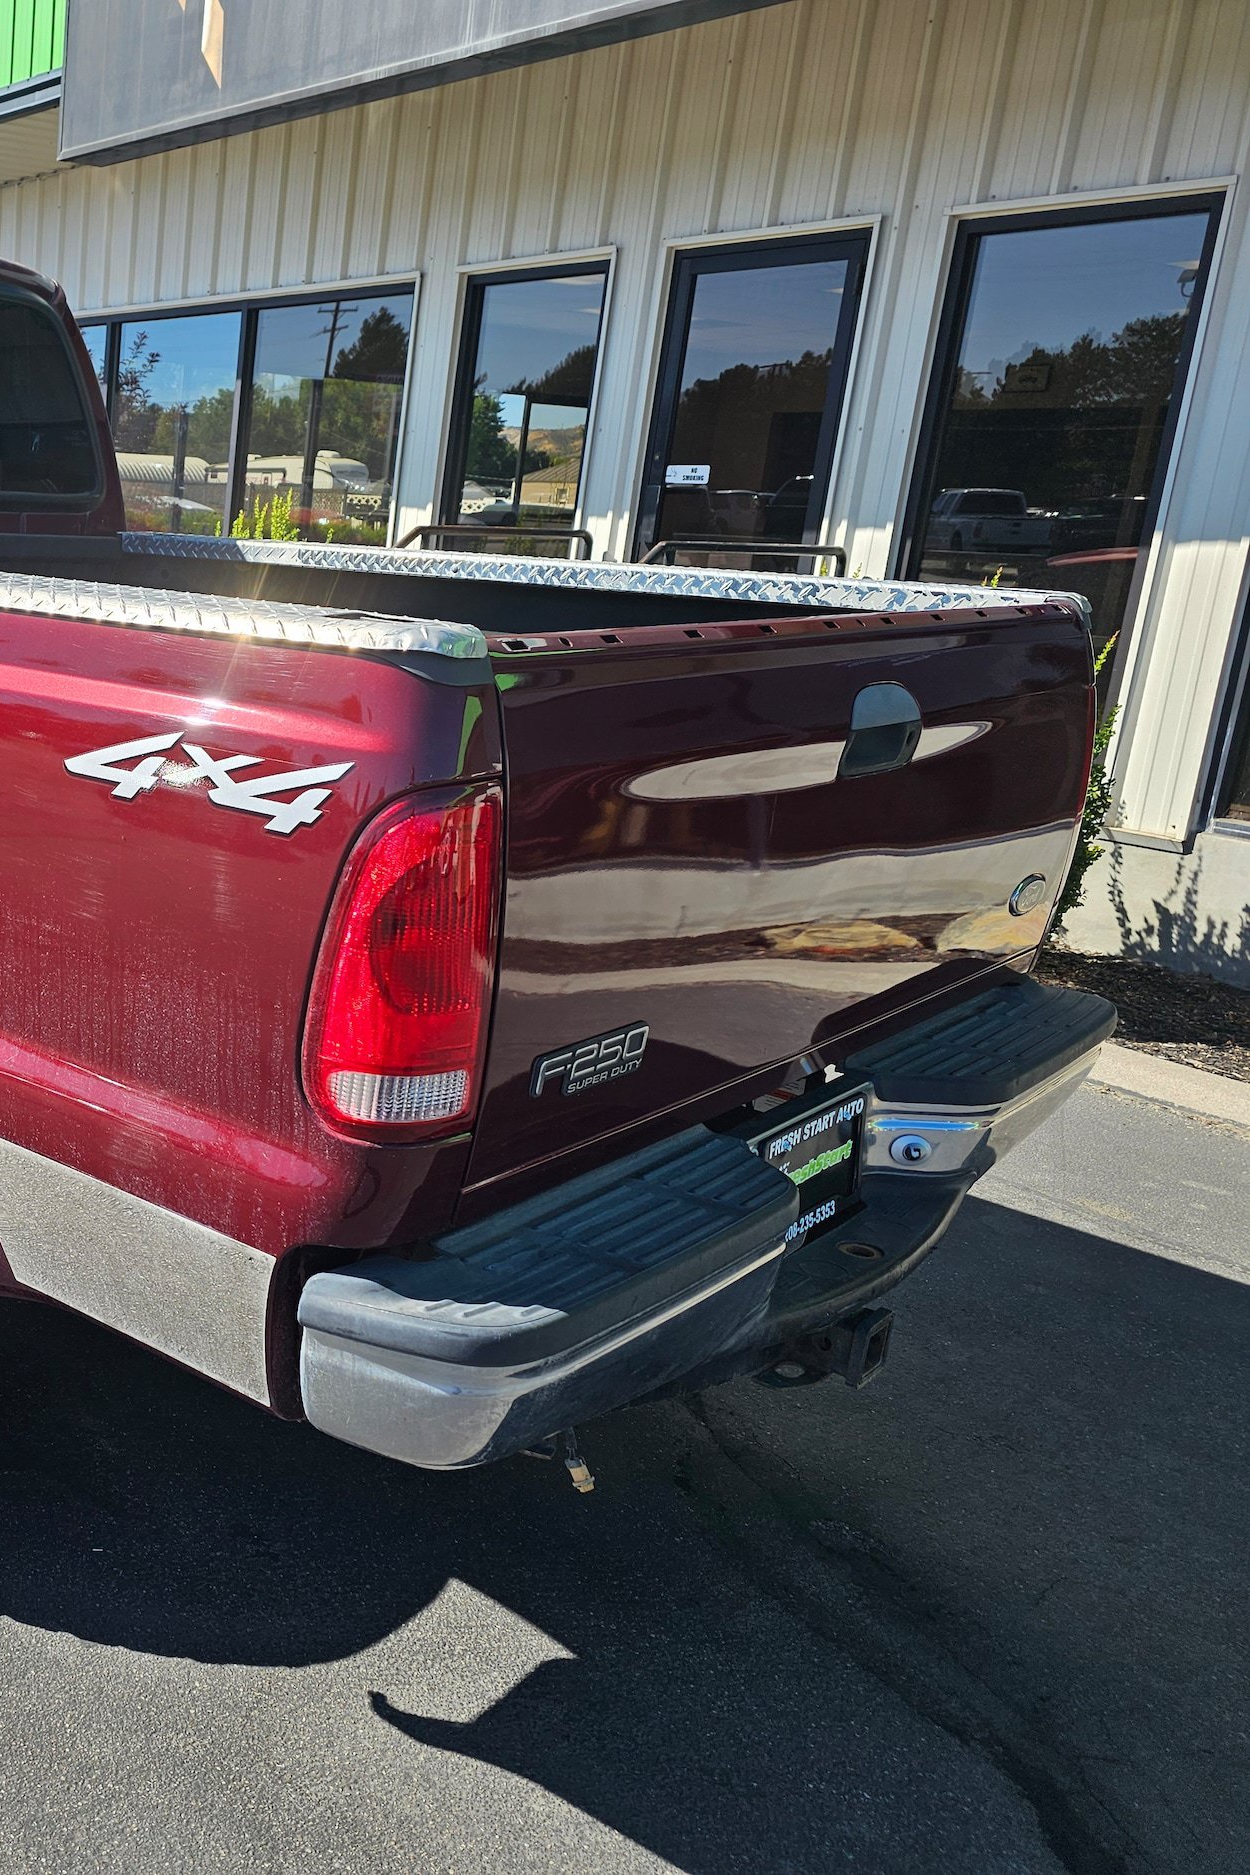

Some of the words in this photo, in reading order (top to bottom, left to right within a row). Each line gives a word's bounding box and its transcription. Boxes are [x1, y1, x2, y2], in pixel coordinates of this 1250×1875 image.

[566, 1071, 609, 1094] SUPER
[610, 1058, 643, 1079] DUTY
[768, 1126, 802, 1160] FRESH
[802, 1110, 837, 1142] START
[836, 1098, 864, 1123] AUTO
[788, 1139, 853, 1186] eshStart
